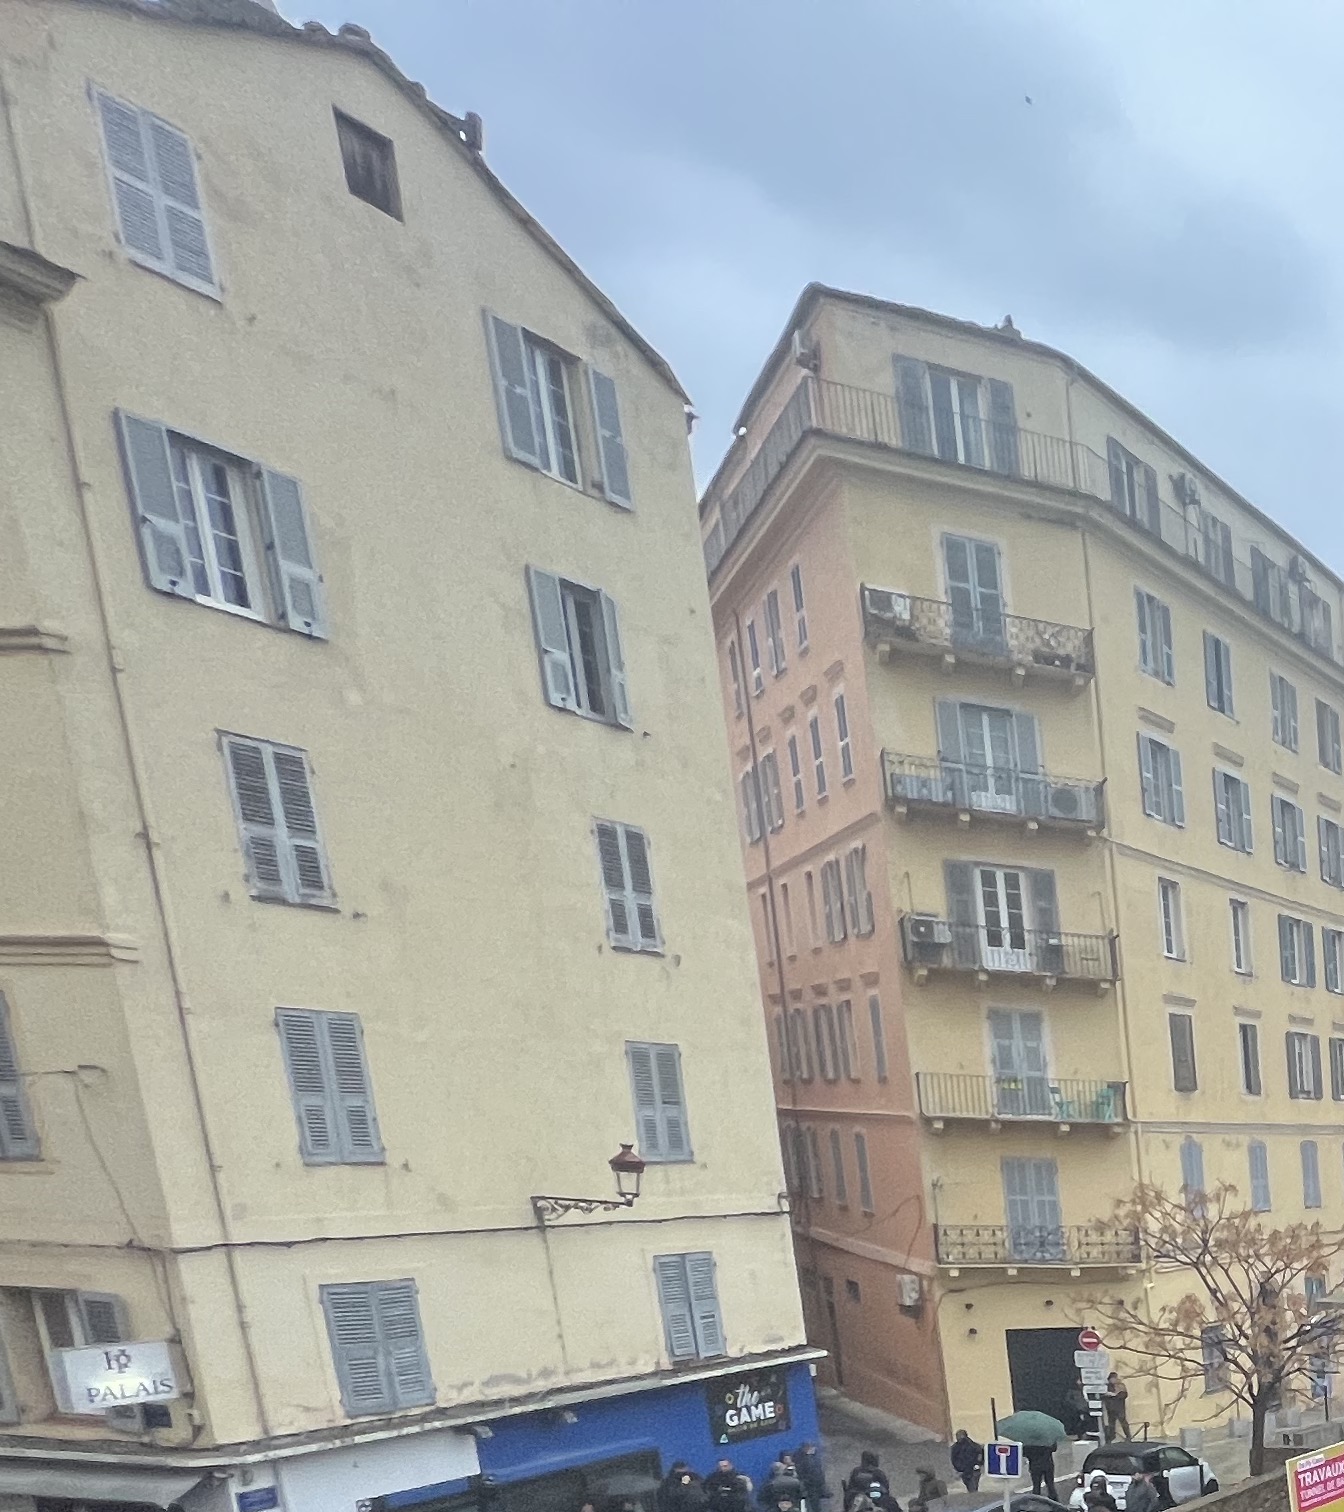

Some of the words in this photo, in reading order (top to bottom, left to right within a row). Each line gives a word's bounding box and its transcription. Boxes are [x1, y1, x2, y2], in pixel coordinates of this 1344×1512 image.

[86, 1378, 174, 1403] PALAIS
[735, 1383, 760, 1408] the
[725, 1401, 776, 1427] GAME
